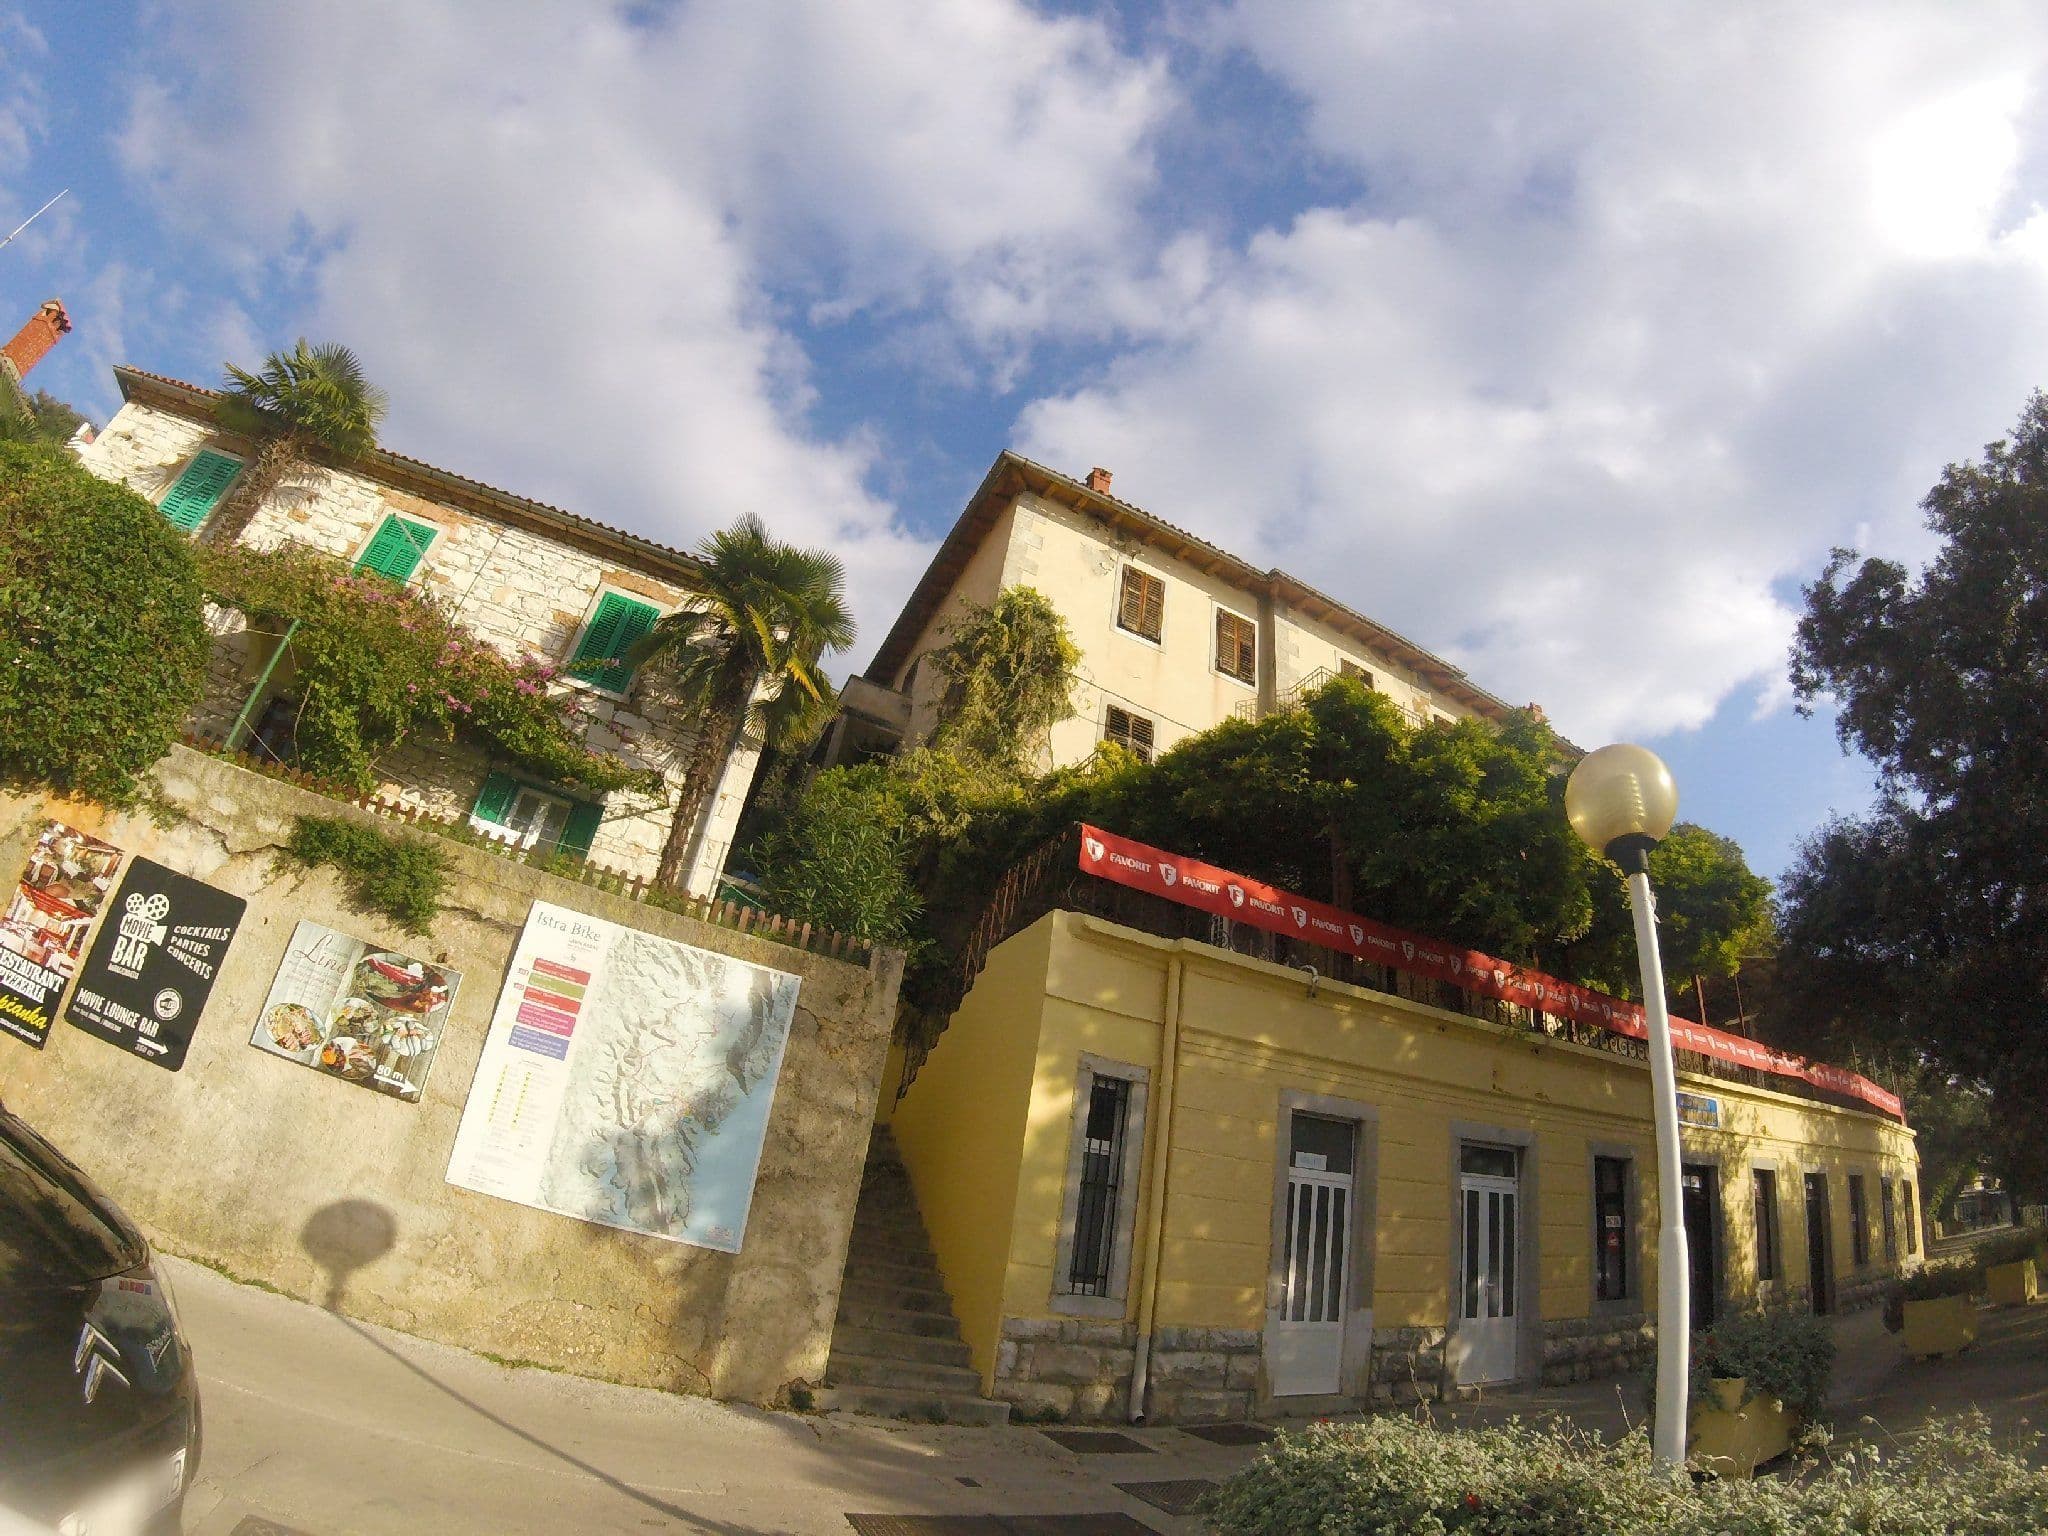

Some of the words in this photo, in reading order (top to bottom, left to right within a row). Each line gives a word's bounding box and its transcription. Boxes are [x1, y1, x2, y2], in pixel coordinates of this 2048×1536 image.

[1110, 853, 1151, 873] FAVORIT
[1183, 876, 1220, 895] FAVORIT
[1250, 897, 1285, 917] FAVORIT
[1312, 917, 1344, 935] FAVORIT
[1367, 936, 1396, 952] FAVORIT
[121, 915, 154, 940] MOVIE
[173, 925, 231, 941] COCKTAILS
[537, 911, 567, 931] Istra
[571, 922, 601, 941] Bike
[110, 935, 148, 971] BAR
[166, 945, 213, 980] CONCERTS
[170, 936, 211, 957] PARTIES
[0, 947, 65, 992] ESTAURANT
[76, 987, 106, 1013] MOVIE
[103, 1000, 140, 1029] LOUNGE
[138, 1016, 160, 1038] BAR
[377, 1064, 391, 1077] 80
[392, 1071, 404, 1081] m
